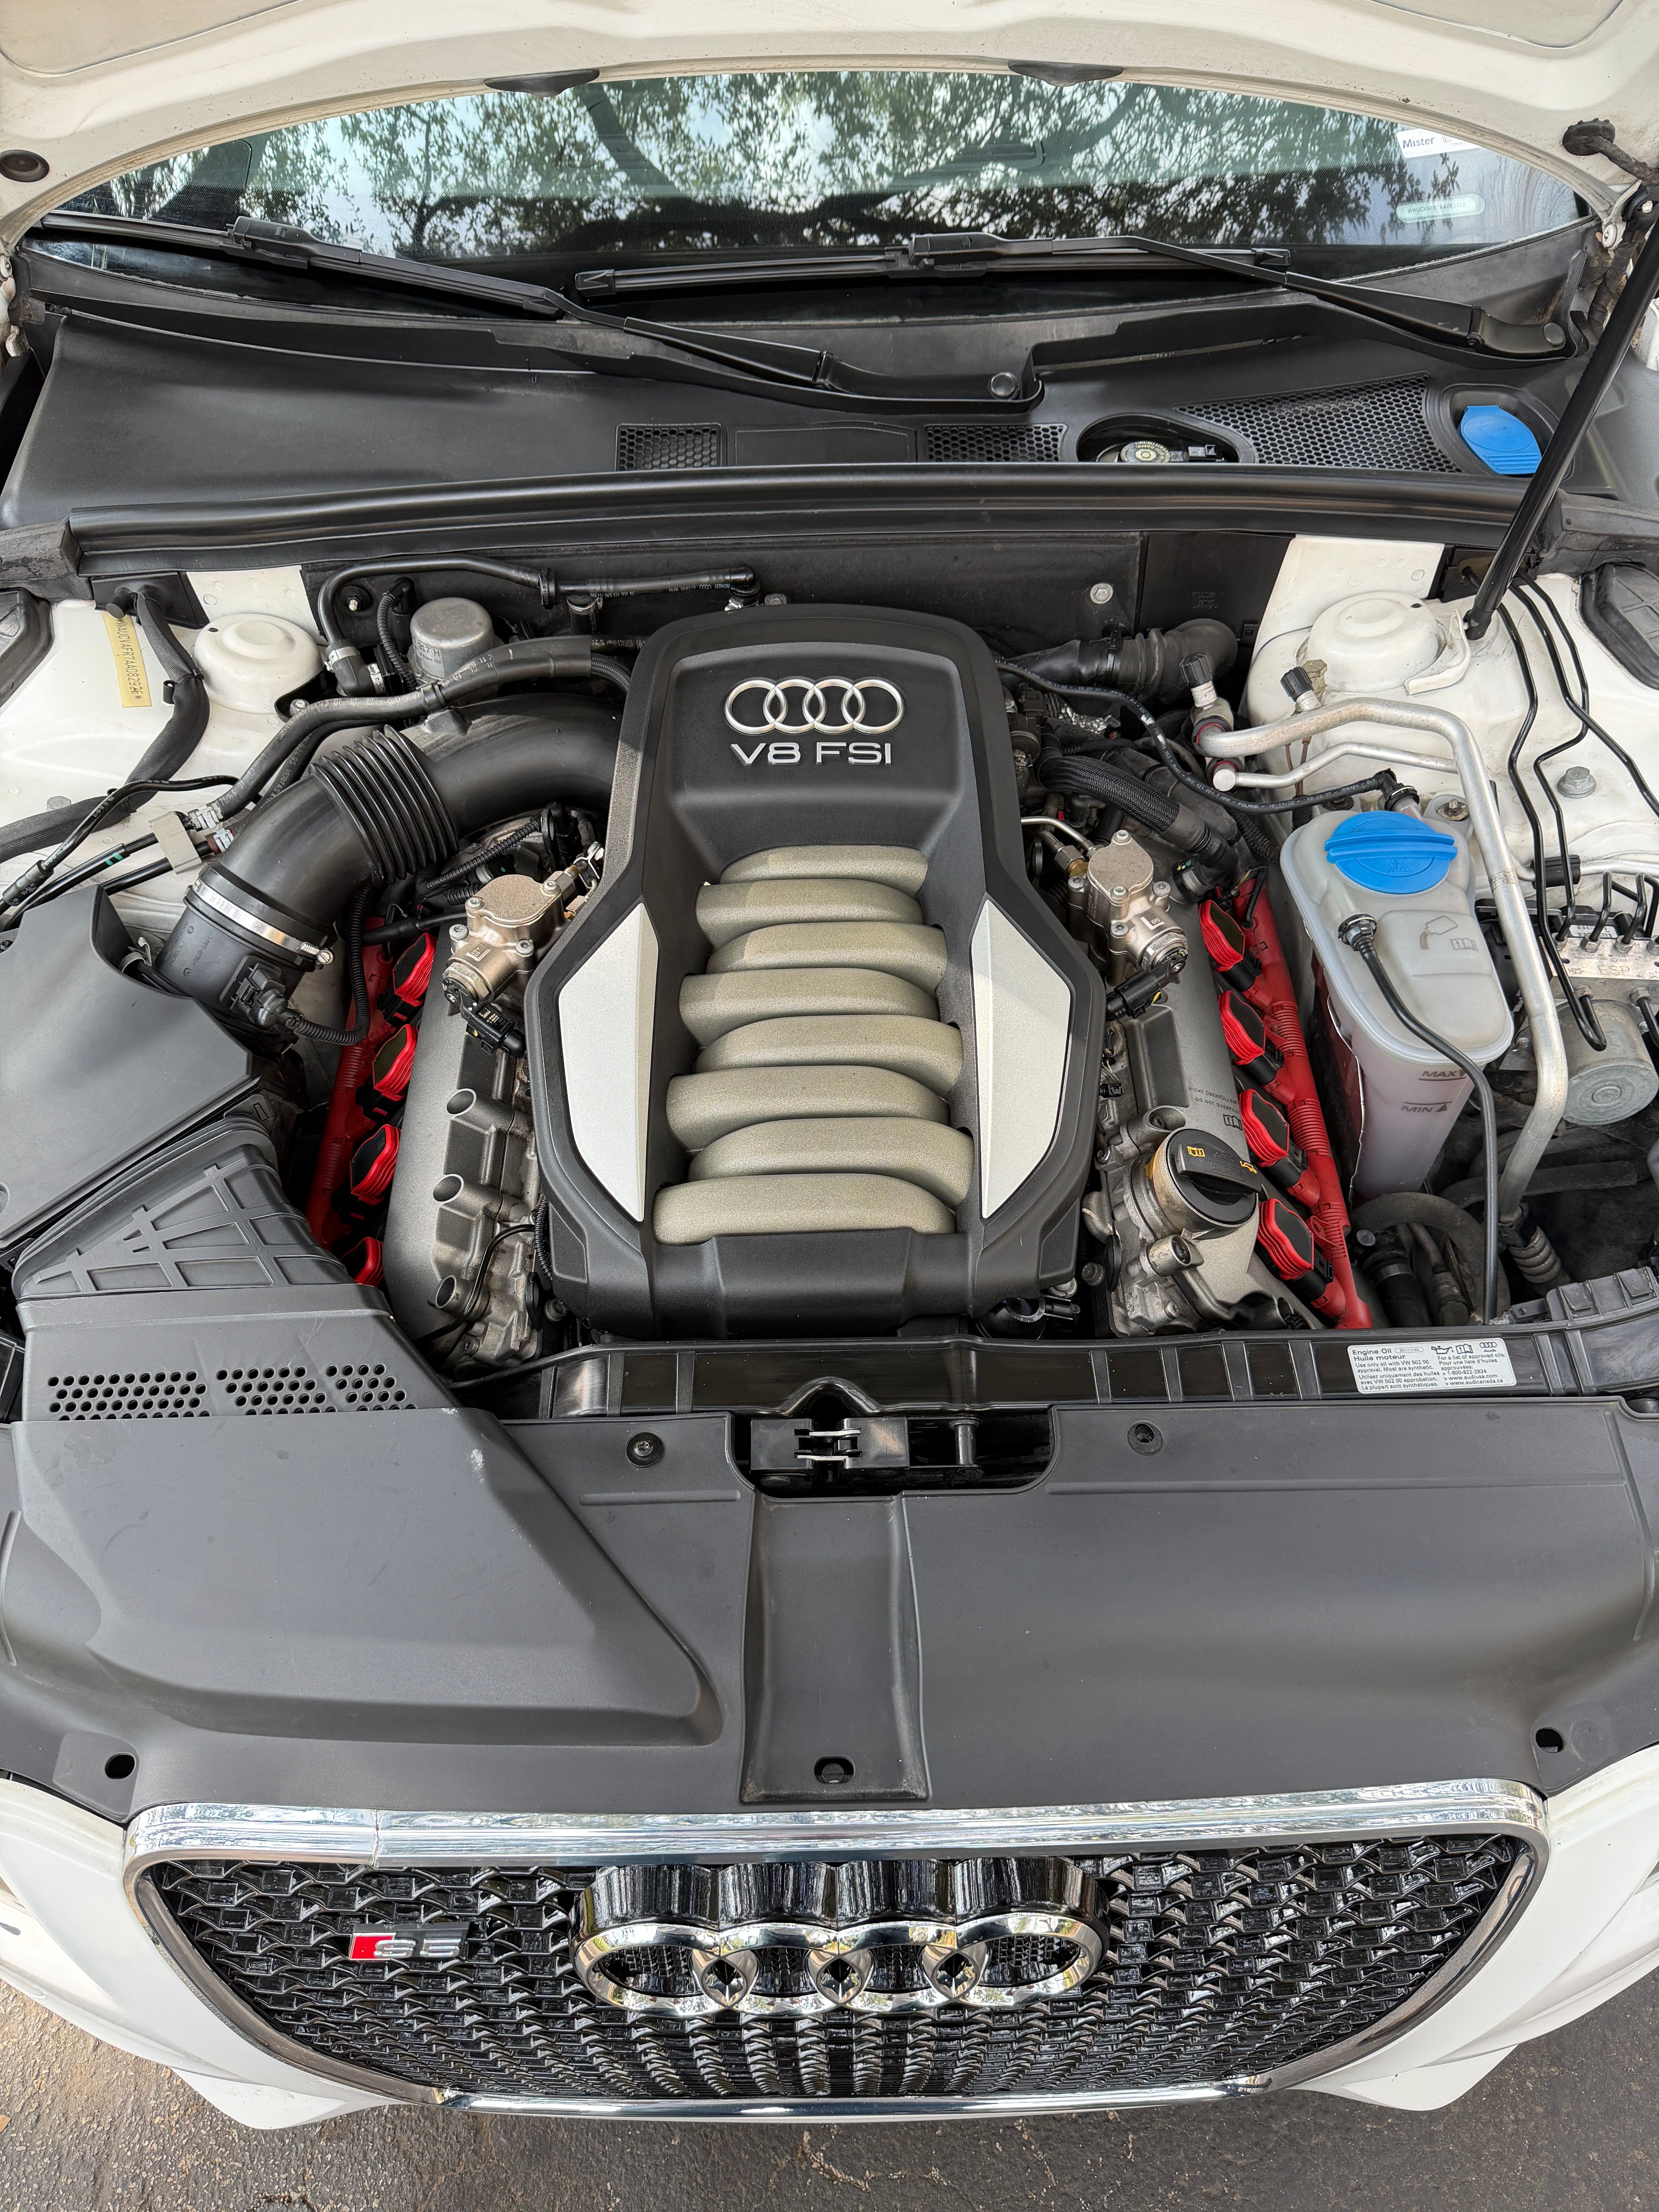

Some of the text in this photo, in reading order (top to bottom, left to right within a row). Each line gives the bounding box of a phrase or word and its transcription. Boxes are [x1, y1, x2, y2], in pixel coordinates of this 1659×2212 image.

[1403, 137, 1434, 149] Mister
[731, 742, 891, 767] V8 FSI
[1172, 764, 1181, 773] Audi
[273, 769, 291, 793] VERITAS
[1597, 965, 1630, 975] ESP
[373, 1939, 461, 1958] S5
